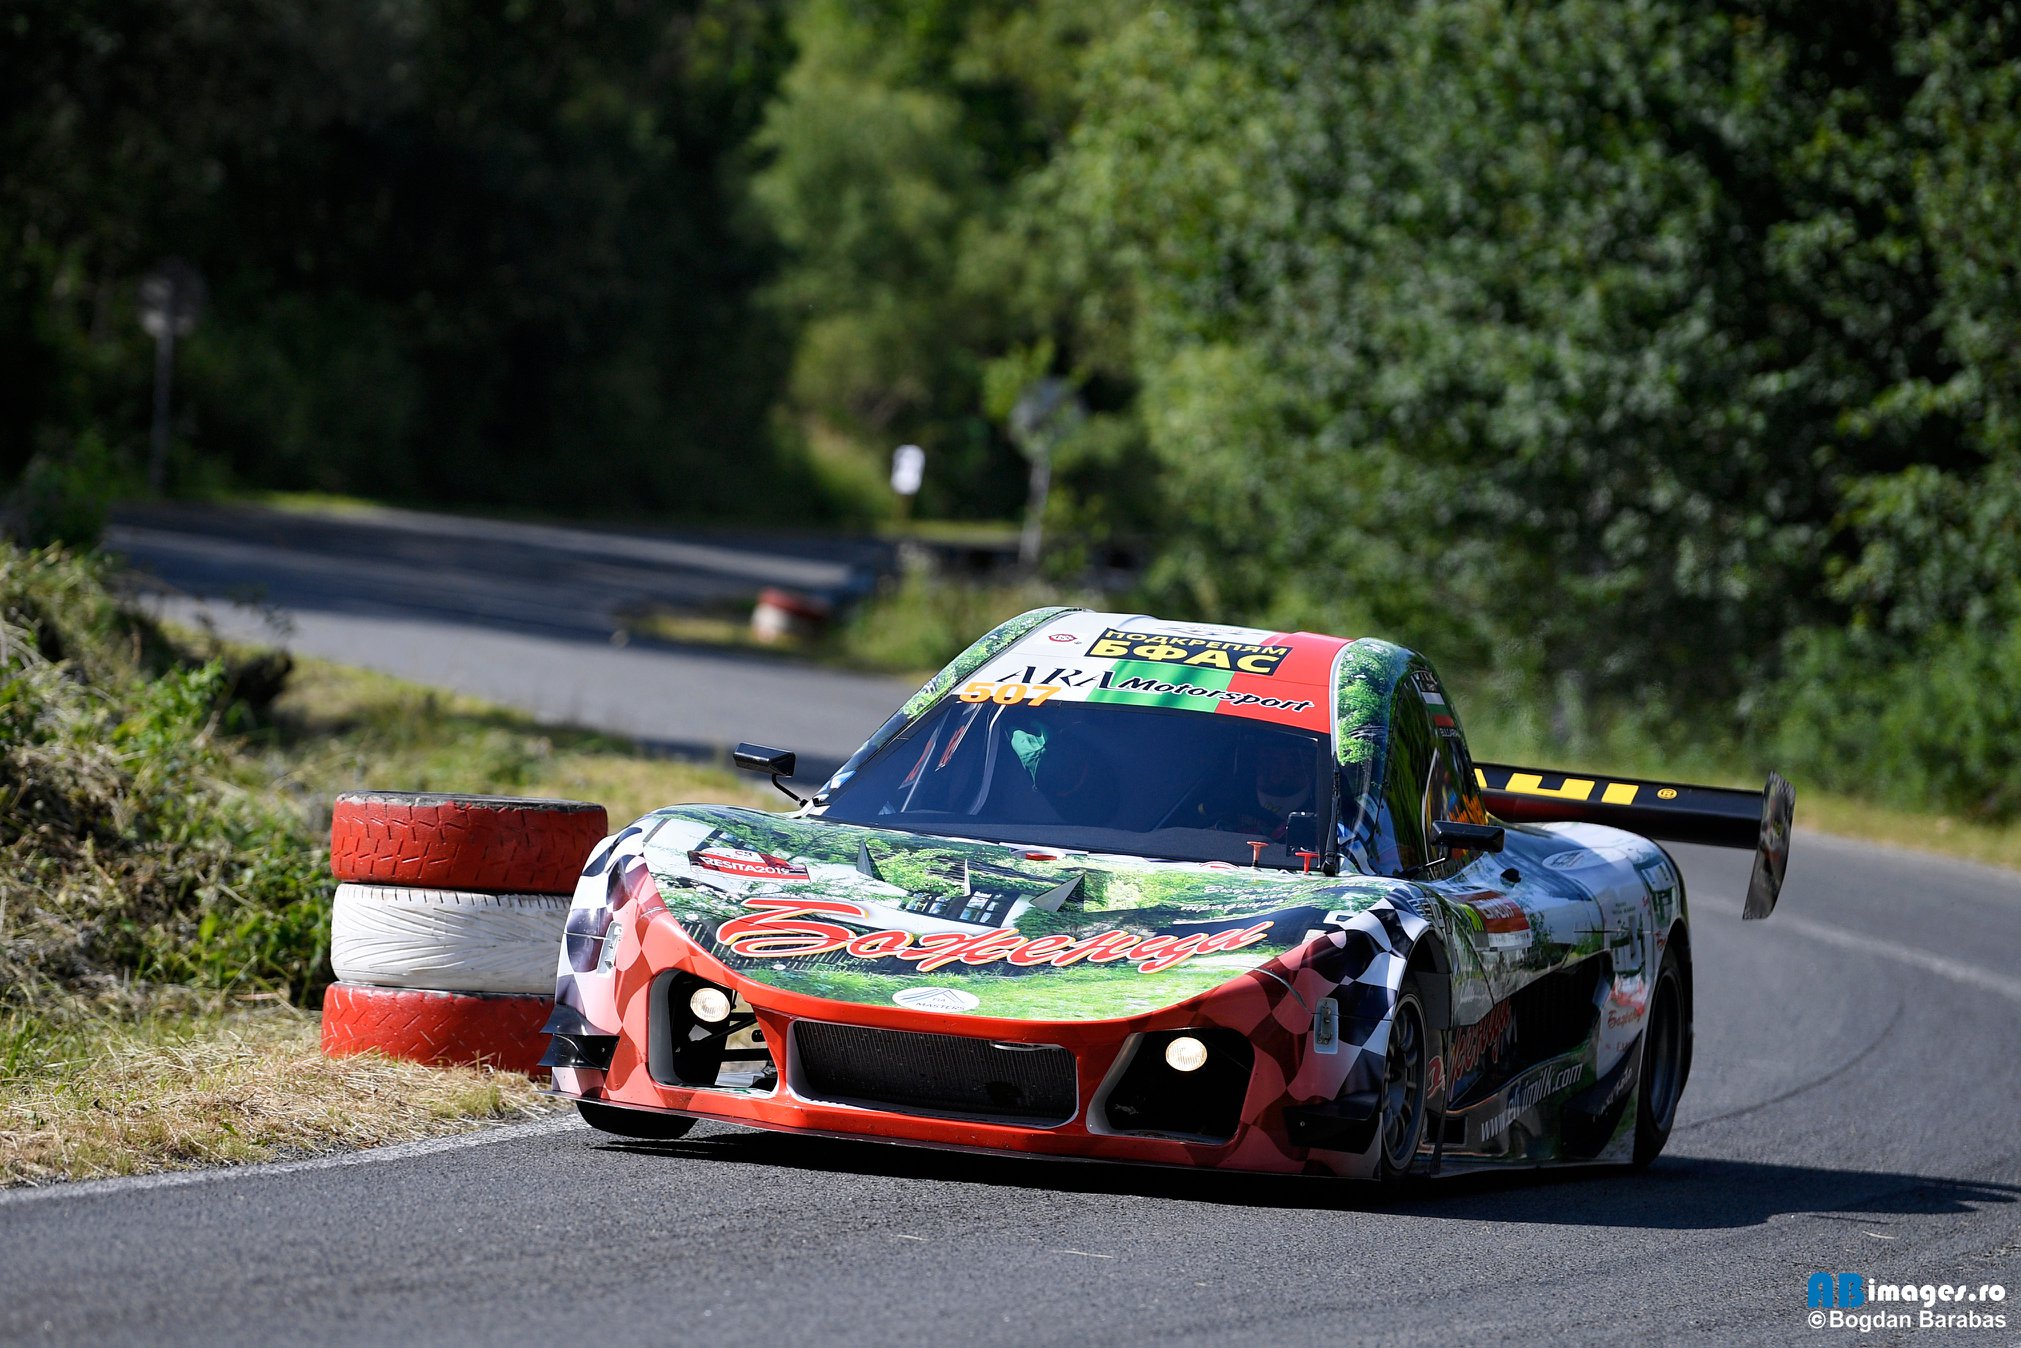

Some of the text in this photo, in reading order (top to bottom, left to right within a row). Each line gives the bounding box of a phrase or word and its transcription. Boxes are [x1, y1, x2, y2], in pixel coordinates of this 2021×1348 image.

[1089, 639, 1280, 673] БФАС
[1106, 629, 1288, 656] ПОДКРЕПЯМ
[959, 681, 1062, 707] 507
[997, 665, 1314, 713] ARA Motorsport
[699, 856, 790, 875] RESITA2019
